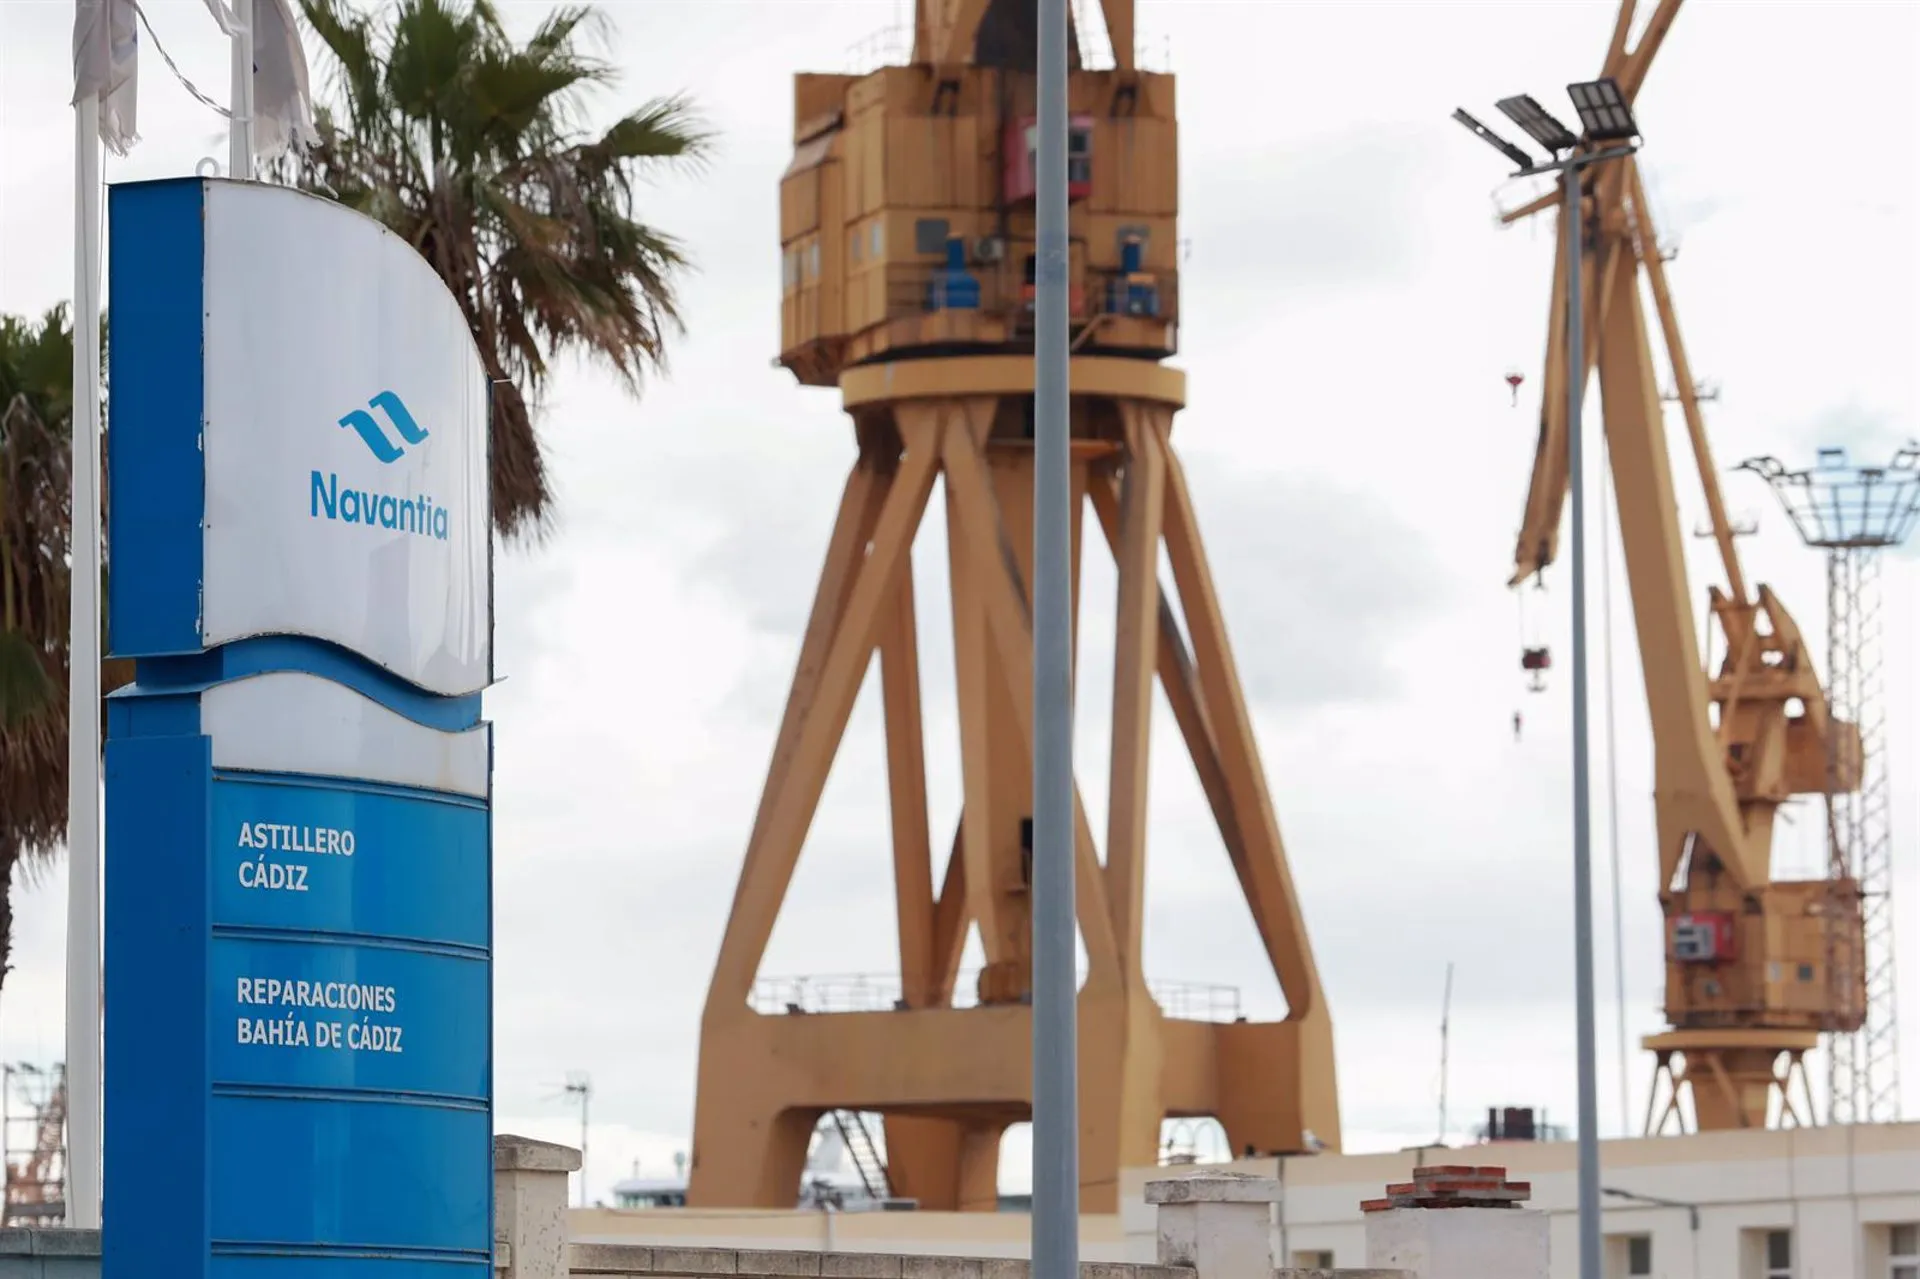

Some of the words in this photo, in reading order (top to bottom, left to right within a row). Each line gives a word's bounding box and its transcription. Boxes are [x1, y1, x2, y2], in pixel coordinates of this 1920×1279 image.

[310, 470, 449, 540] Navantia
[238, 822, 356, 857] ASTILLERO
[238, 853, 309, 892] CÁDIZ
[237, 977, 396, 1013] REPARACIONES
[237, 1011, 310, 1047] BAHÍA
[315, 1021, 342, 1049] DE
[347, 1016, 403, 1053] CÁDIZ
